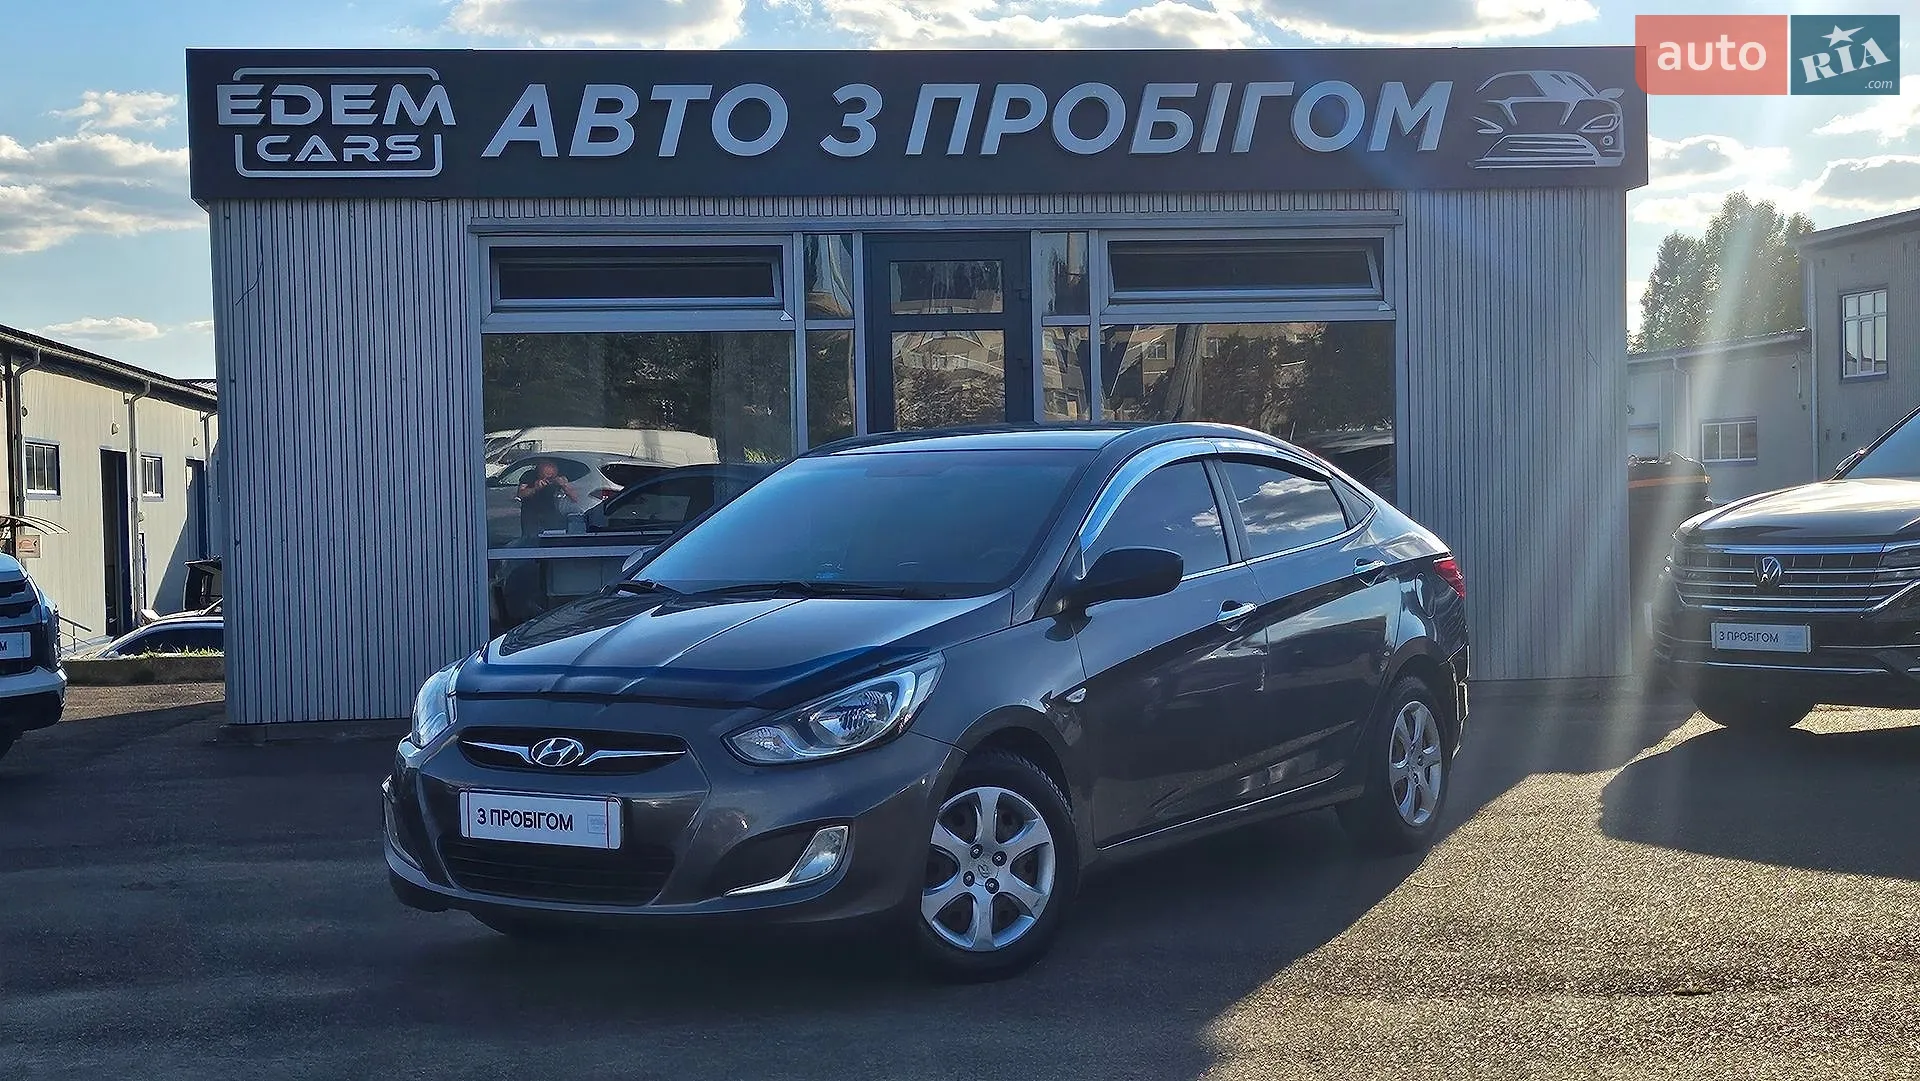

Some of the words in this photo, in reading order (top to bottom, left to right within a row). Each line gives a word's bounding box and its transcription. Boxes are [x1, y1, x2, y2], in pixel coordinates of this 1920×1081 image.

[217, 84, 457, 126] EDEM
[481, 83, 789, 158] АВТО
[905, 81, 1454, 156] ПРОБІГОМ
[256, 134, 422, 162] CARS
[1727, 631, 1779, 643] ПРОБІГОМ
[490, 809, 573, 831] ПРОБІГОМ
